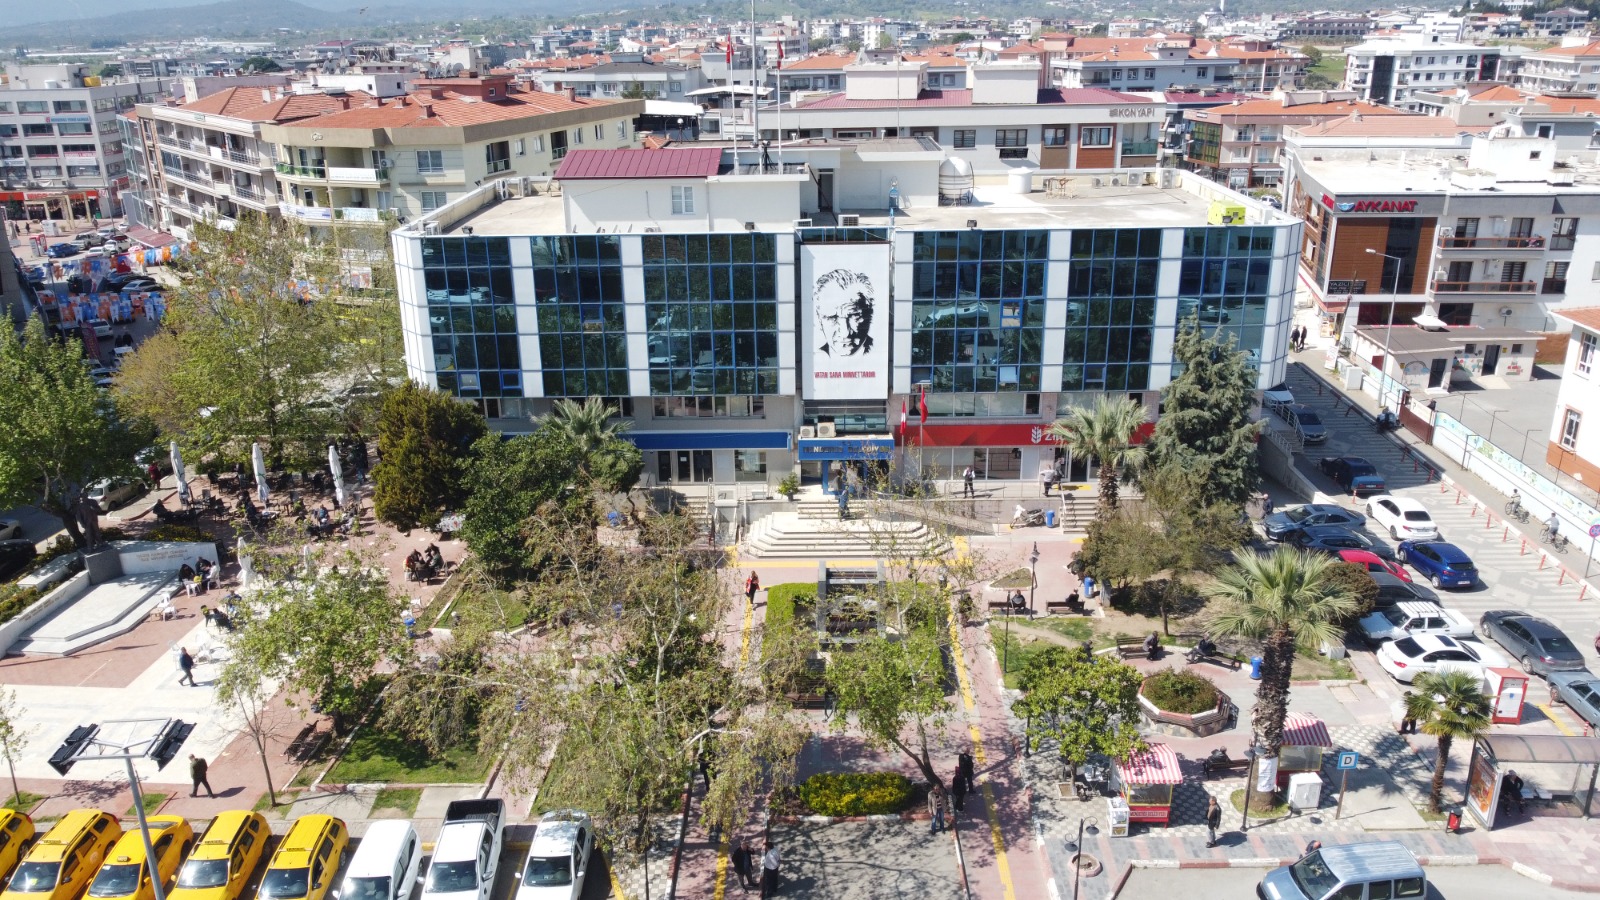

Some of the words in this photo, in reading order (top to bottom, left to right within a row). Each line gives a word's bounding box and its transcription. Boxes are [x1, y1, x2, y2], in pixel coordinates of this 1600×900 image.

[1118, 107, 1155, 118] KONYAPI
[1354, 200, 1418, 212] AYKANAT
[1344, 756, 1352, 765] D
